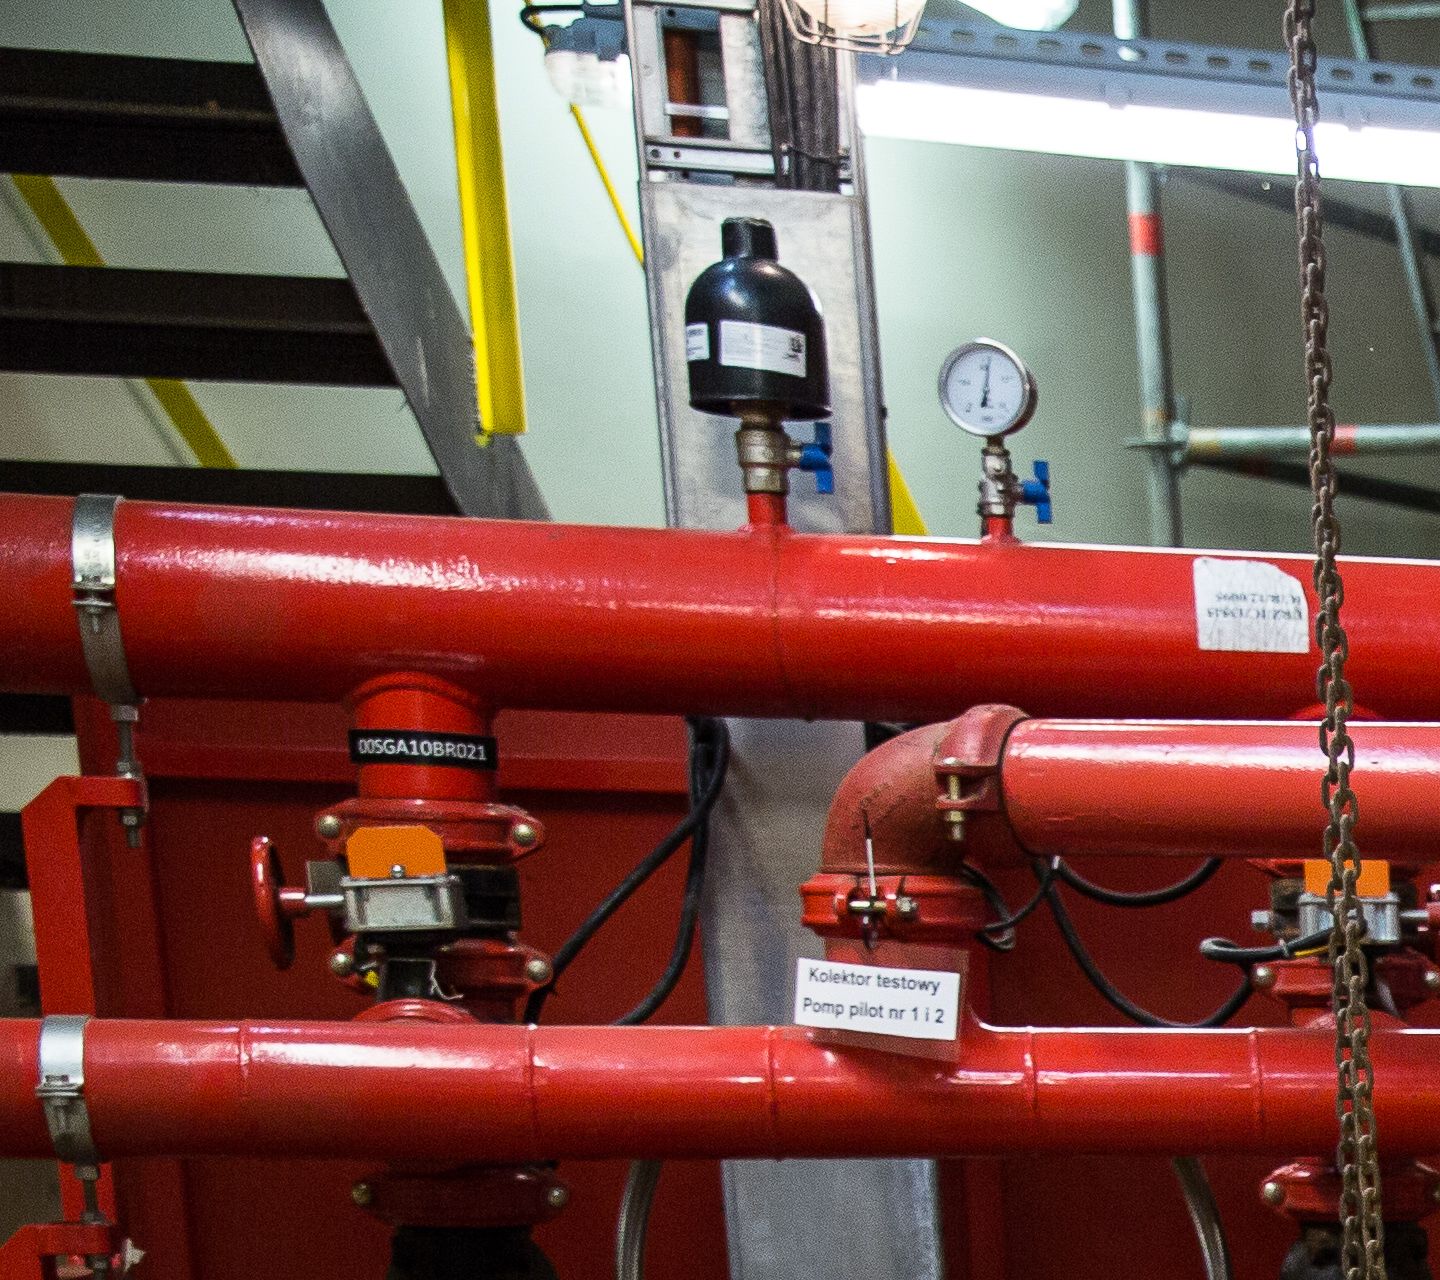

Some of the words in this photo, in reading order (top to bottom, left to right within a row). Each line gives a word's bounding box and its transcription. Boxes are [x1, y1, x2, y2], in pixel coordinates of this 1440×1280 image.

[809, 967, 872, 986] Kolektor
[877, 973, 941, 996] testowy
[802, 997, 845, 1018] Pomp
[849, 1000, 884, 1020] pilot
[888, 1009, 906, 1021] nr
[911, 1007, 919, 1020] 1
[935, 1009, 945, 1023] 2
